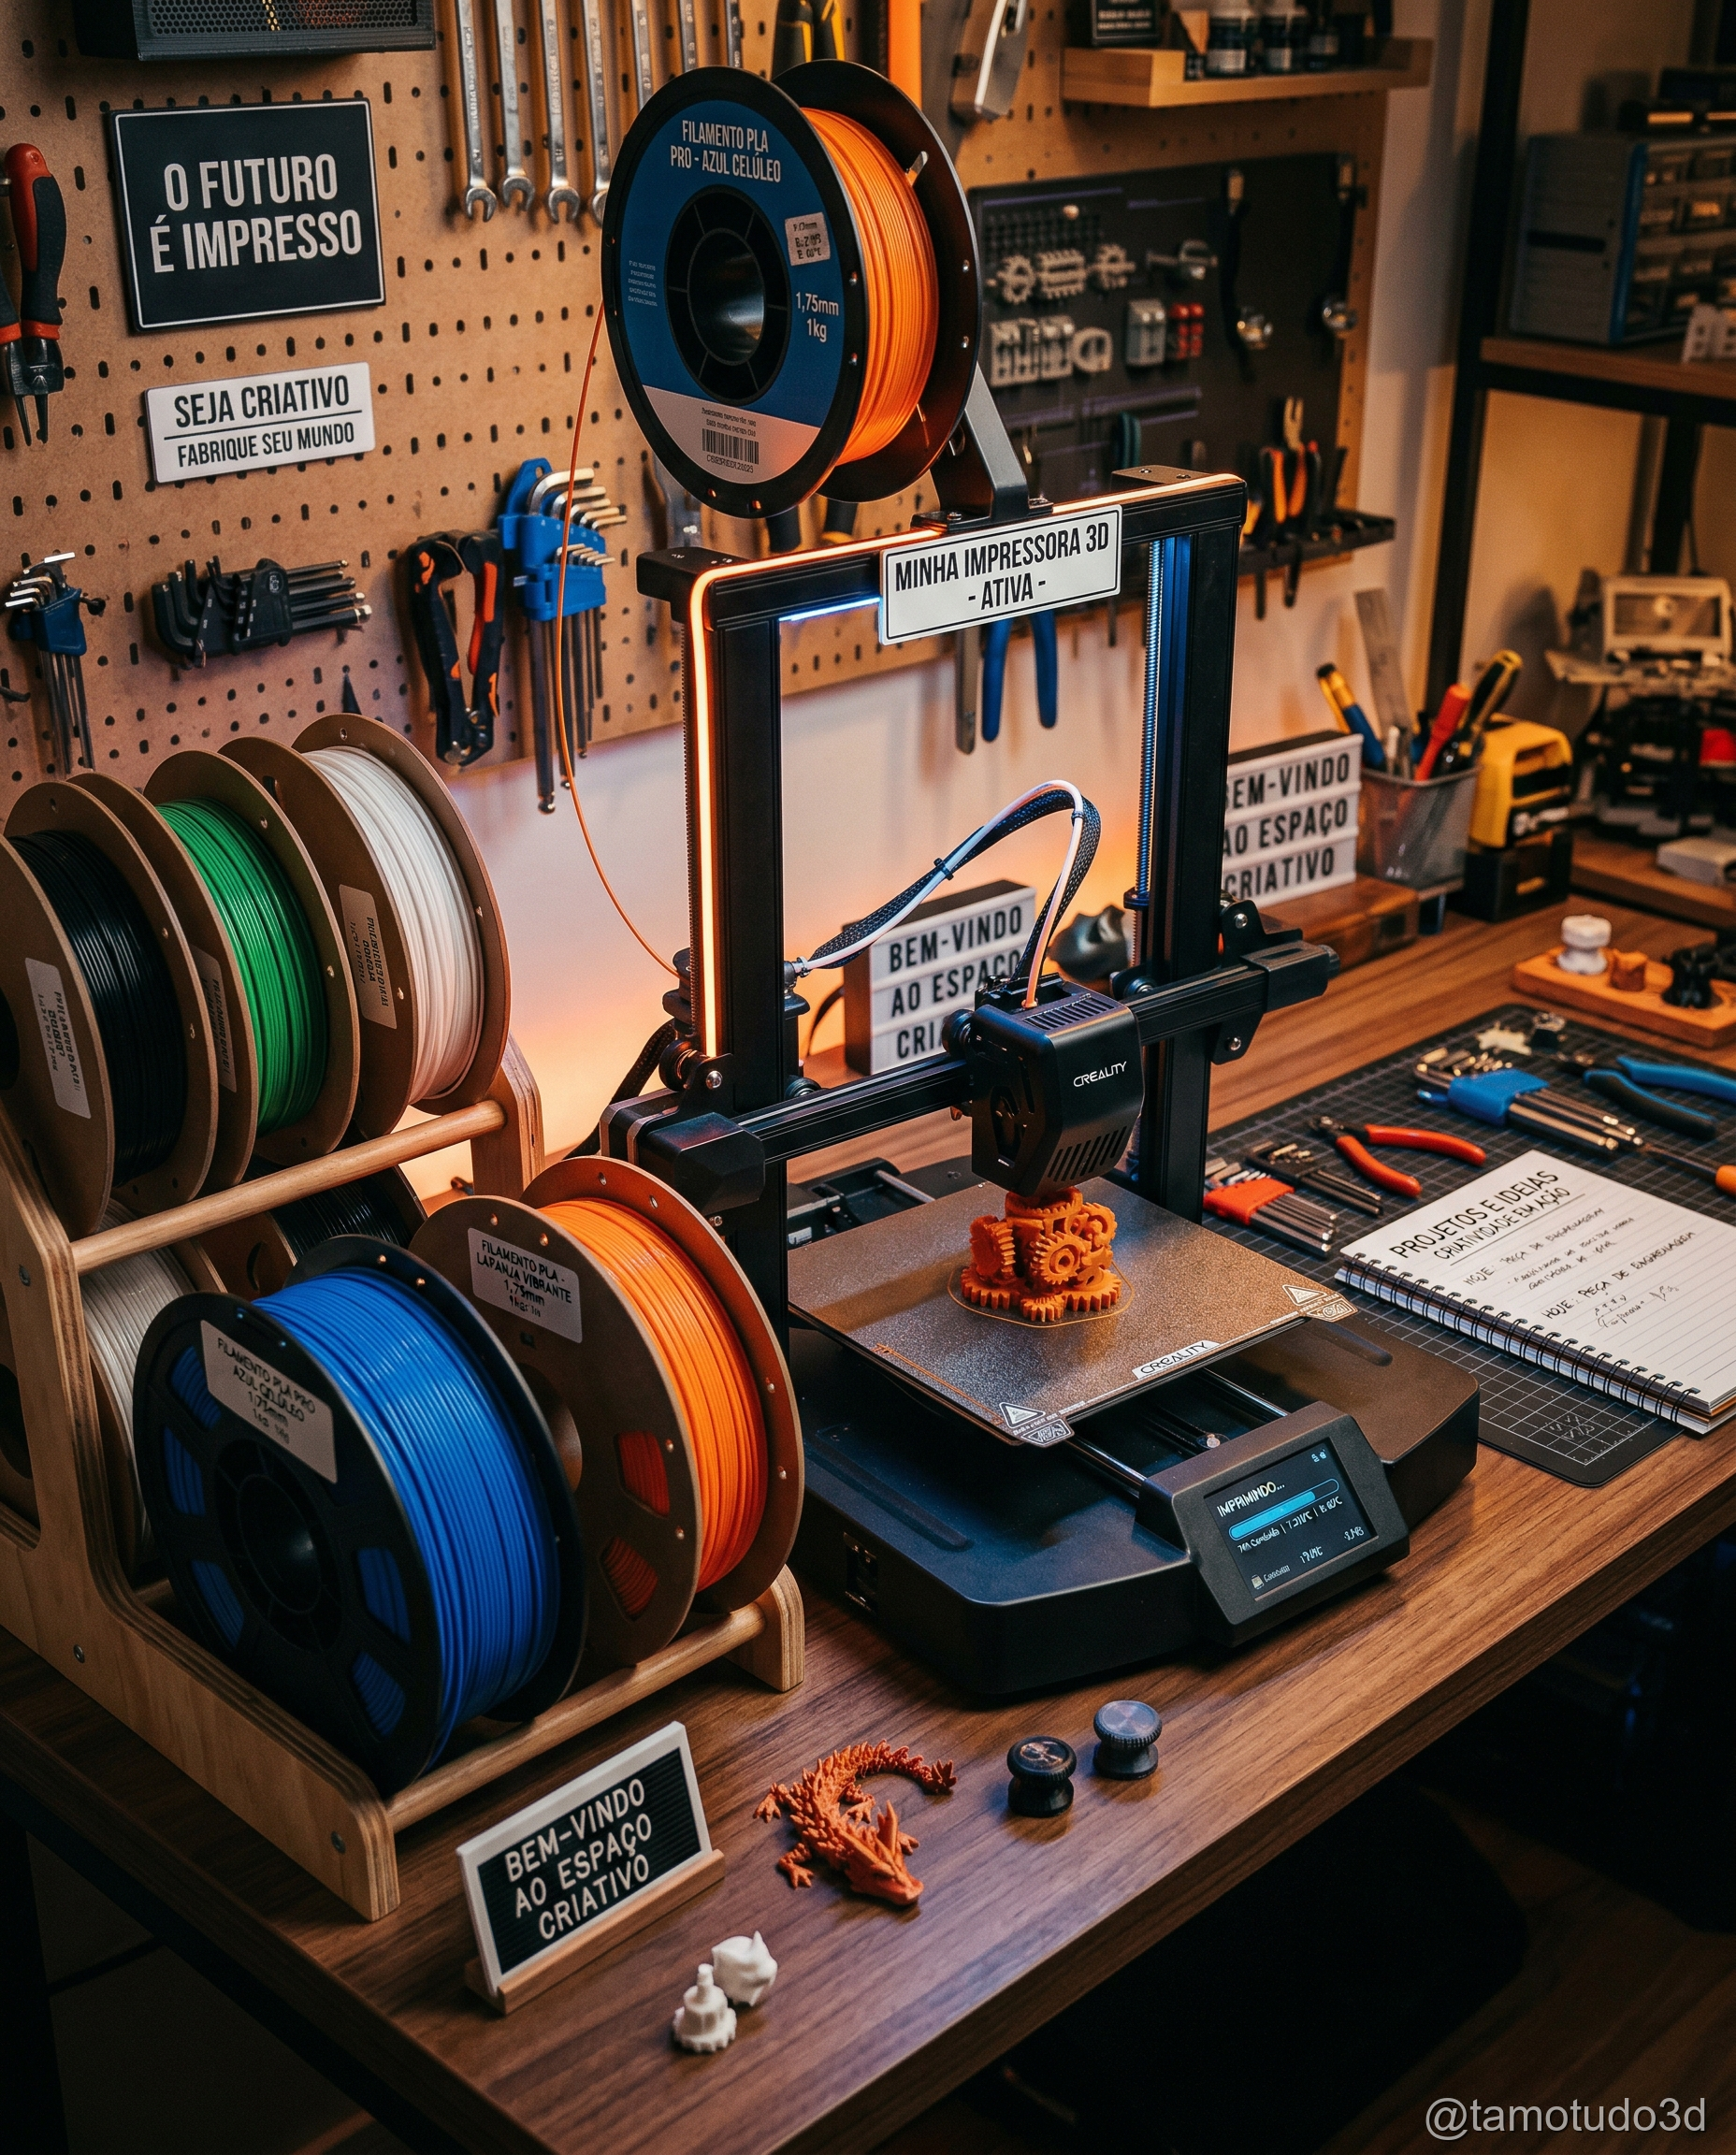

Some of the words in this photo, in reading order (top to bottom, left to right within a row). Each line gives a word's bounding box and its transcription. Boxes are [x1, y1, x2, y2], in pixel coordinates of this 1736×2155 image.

[682, 120, 744, 150] FILAMENTO
[746, 128, 769, 152] PLA
[164, 163, 189, 211] O
[199, 153, 338, 209] FUTURO
[671, 145, 692, 168] PRO
[702, 150, 731, 175] AZUL
[732, 152, 781, 183] CELÚLEO
[150, 214, 175, 273] É
[182, 209, 363, 270] IMPRESSO
[795, 291, 840, 316] 1,75mm
[806, 318, 828, 343] 1kg
[174, 389, 235, 428] SEJA
[240, 375, 350, 419] CRIATIVO
[178, 435, 258, 468] FABRIQUE
[262, 430, 293, 455] SEU
[297, 422, 354, 450] MUNDO
[895, 551, 959, 592] MINHA
[964, 528, 1081, 578] IMPRESSORA
[1086, 522, 1109, 554] 3D
[980, 572, 1034, 611] ATIVA
[1259, 798, 1348, 849] ESPAÇO
[1224, 846, 1335, 900] CRIATIVO
[890, 905, 1022, 973] BEM-VINDO
[890, 982, 920, 1018] AO
[1073, 1061, 1127, 1088] CREALITY
[1389, 1208, 1488, 1259] PROJETOS
[1480, 1199, 1505, 1213] E
[1494, 1170, 1558, 1206] IDEIAS
[482, 1239, 537, 1272] FILAMENTO
[539, 1263, 559, 1283] PLA
[523, 1270, 572, 1304] VIBRANTE
[1140, 1341, 1208, 1374] CREALITY
[504, 1778, 645, 1883] BEM-VINDO
[515, 1876, 547, 1918] AO
[557, 1813, 652, 1891] ESPAÇO
[539, 1854, 649, 1940] CRIATIVO
